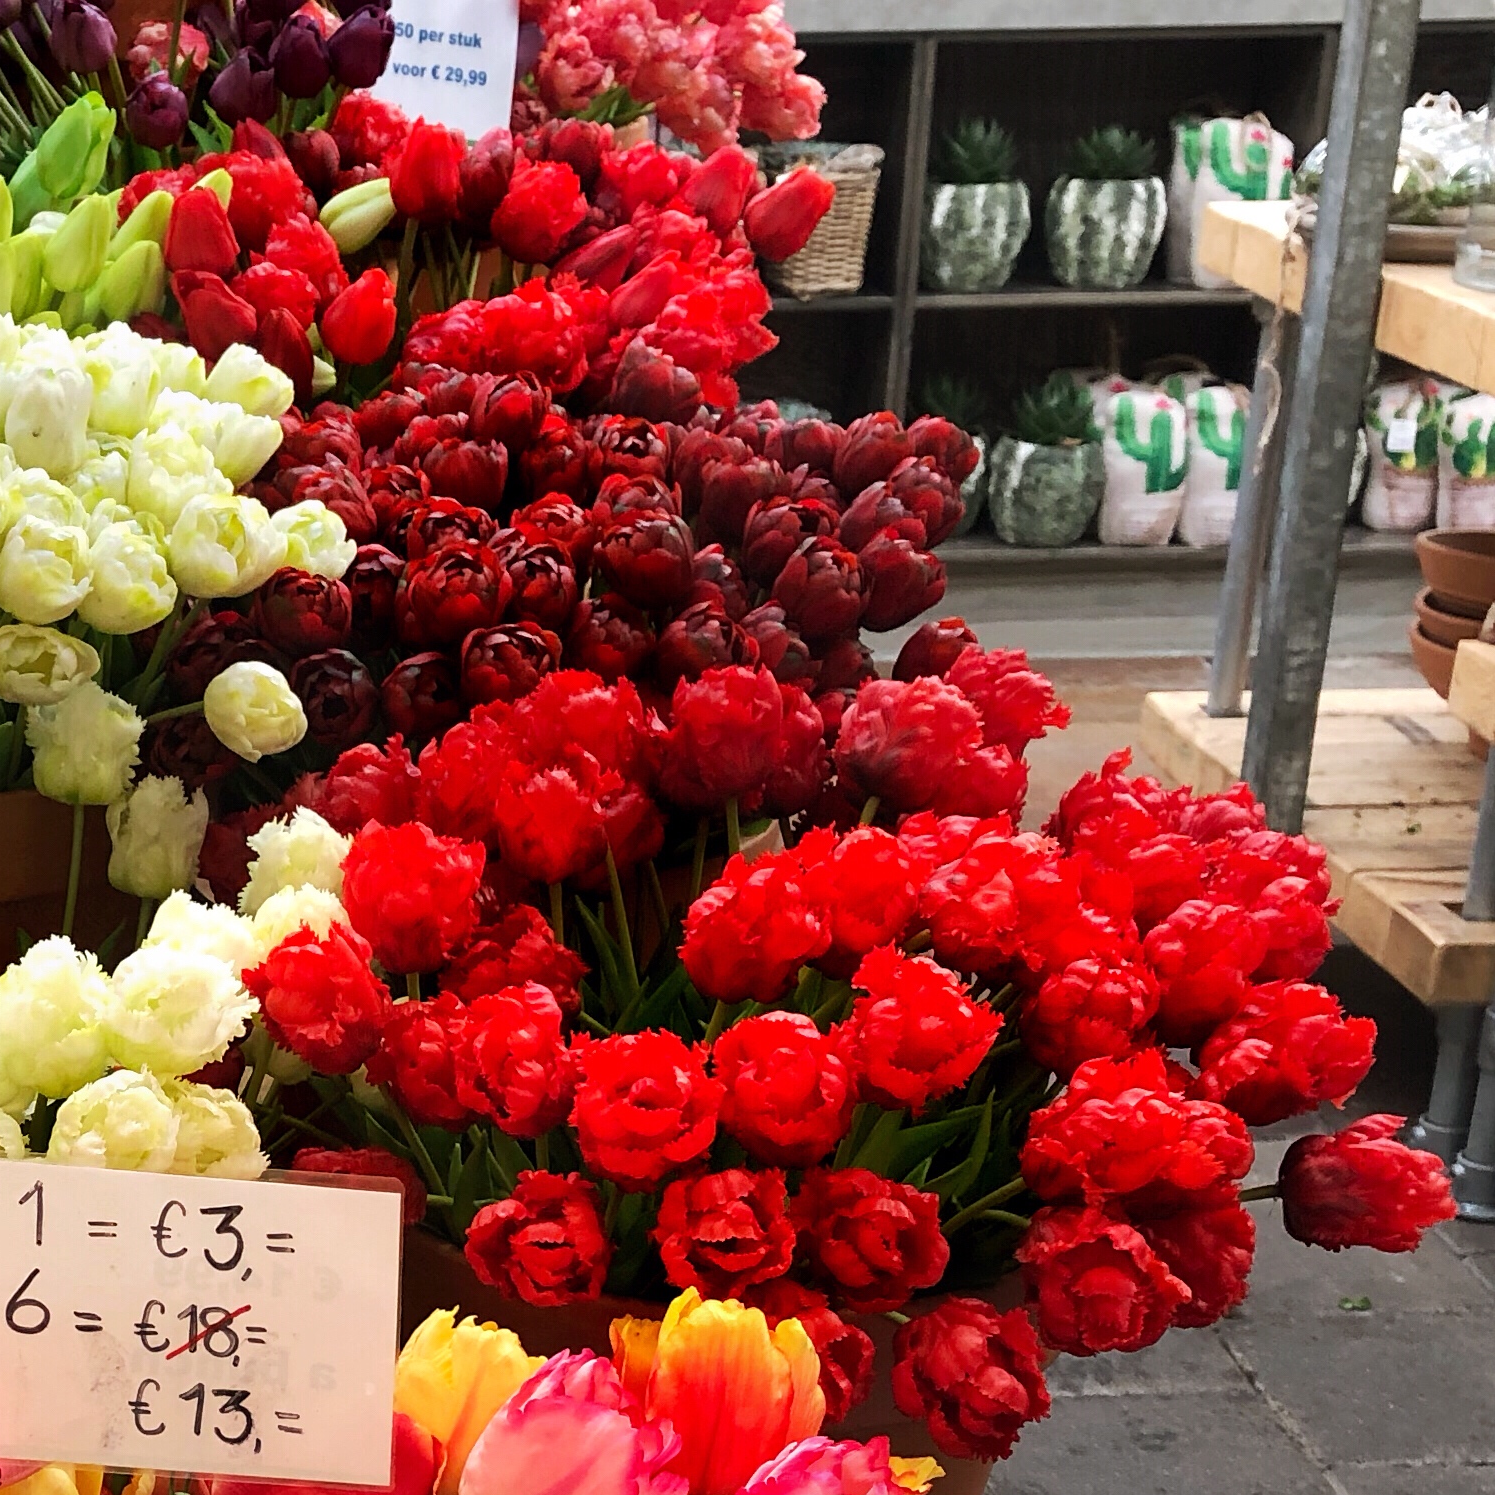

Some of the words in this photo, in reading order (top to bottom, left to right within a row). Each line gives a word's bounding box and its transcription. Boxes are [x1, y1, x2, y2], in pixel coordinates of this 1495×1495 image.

[394, 22, 414, 38] 50
[418, 28, 444, 44] per
[448, 32, 482, 48] stuk
[392, 62, 426, 78] voor
[431, 64, 441, 80] €
[445, 66, 487, 86] 29,99
[19, 1180, 44, 1246] 1
[5, 1268, 51, 1335] 6
